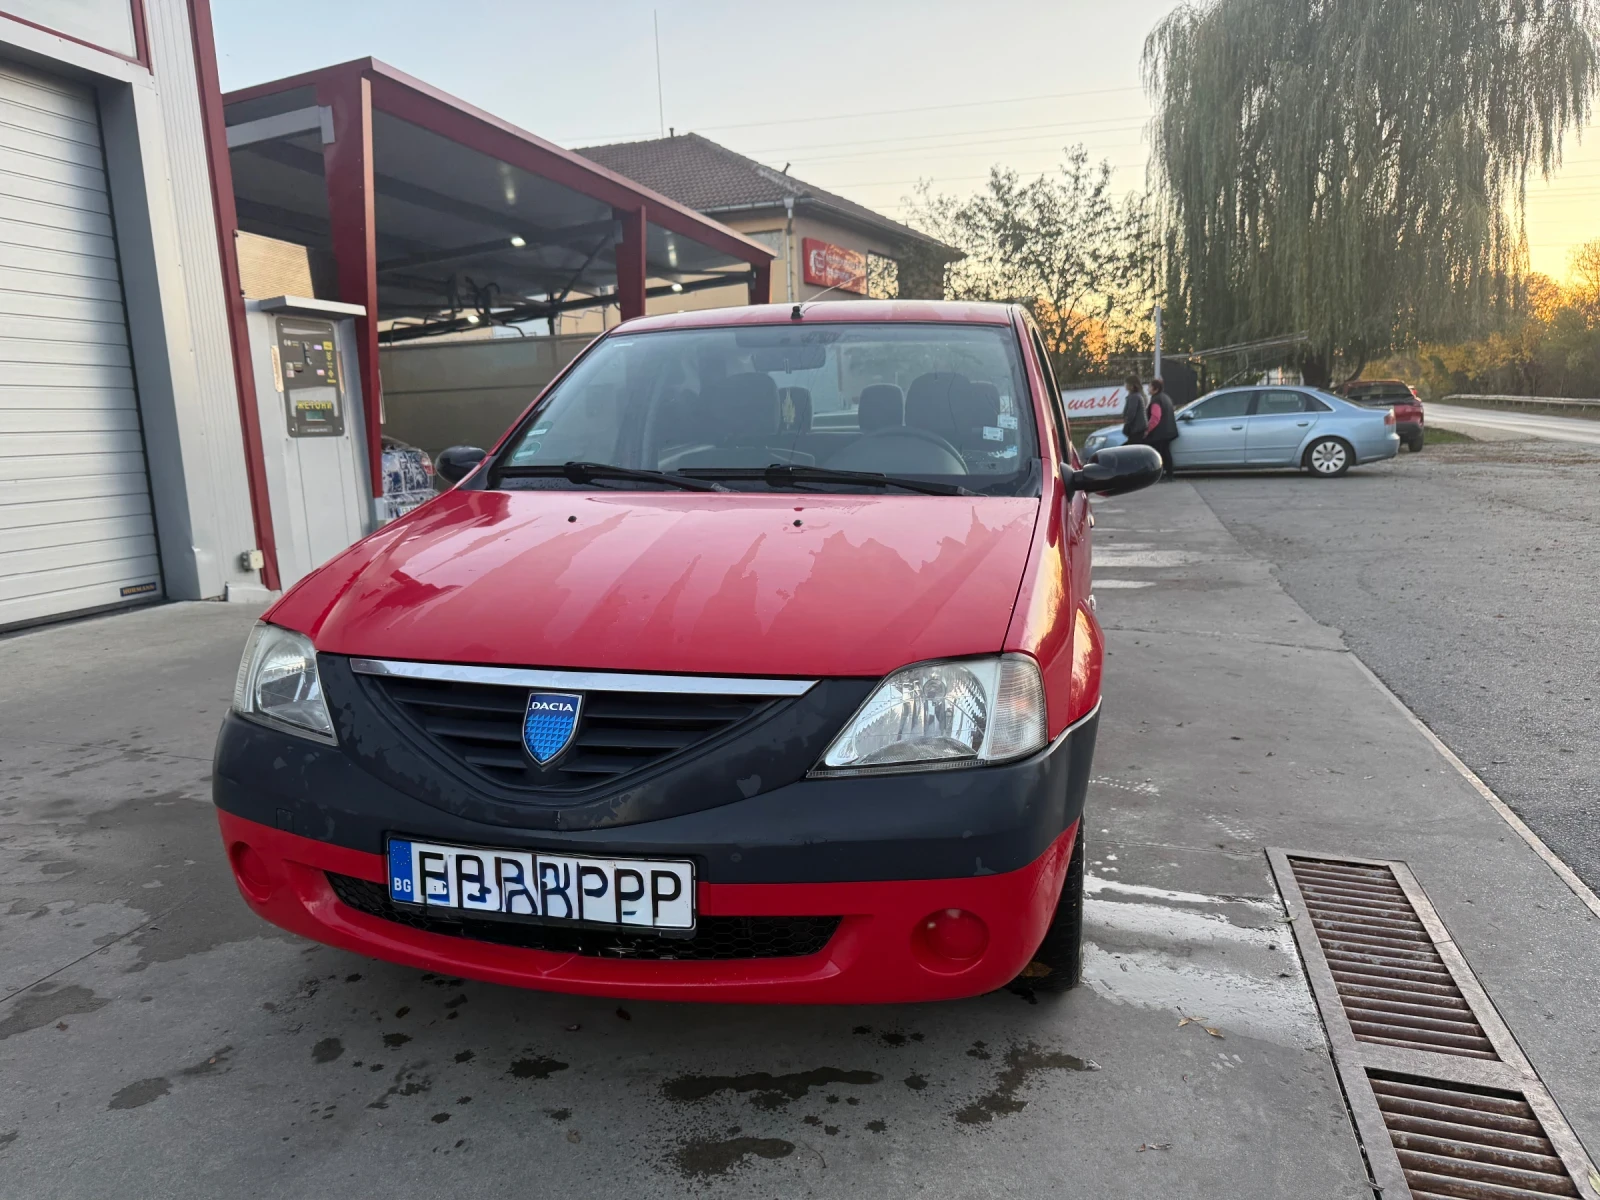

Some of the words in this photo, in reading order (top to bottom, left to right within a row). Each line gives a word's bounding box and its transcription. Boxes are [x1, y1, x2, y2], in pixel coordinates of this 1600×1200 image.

[1068, 388, 1120, 410] wash
[529, 701, 574, 712] DACIA
[393, 877, 412, 894] BG
